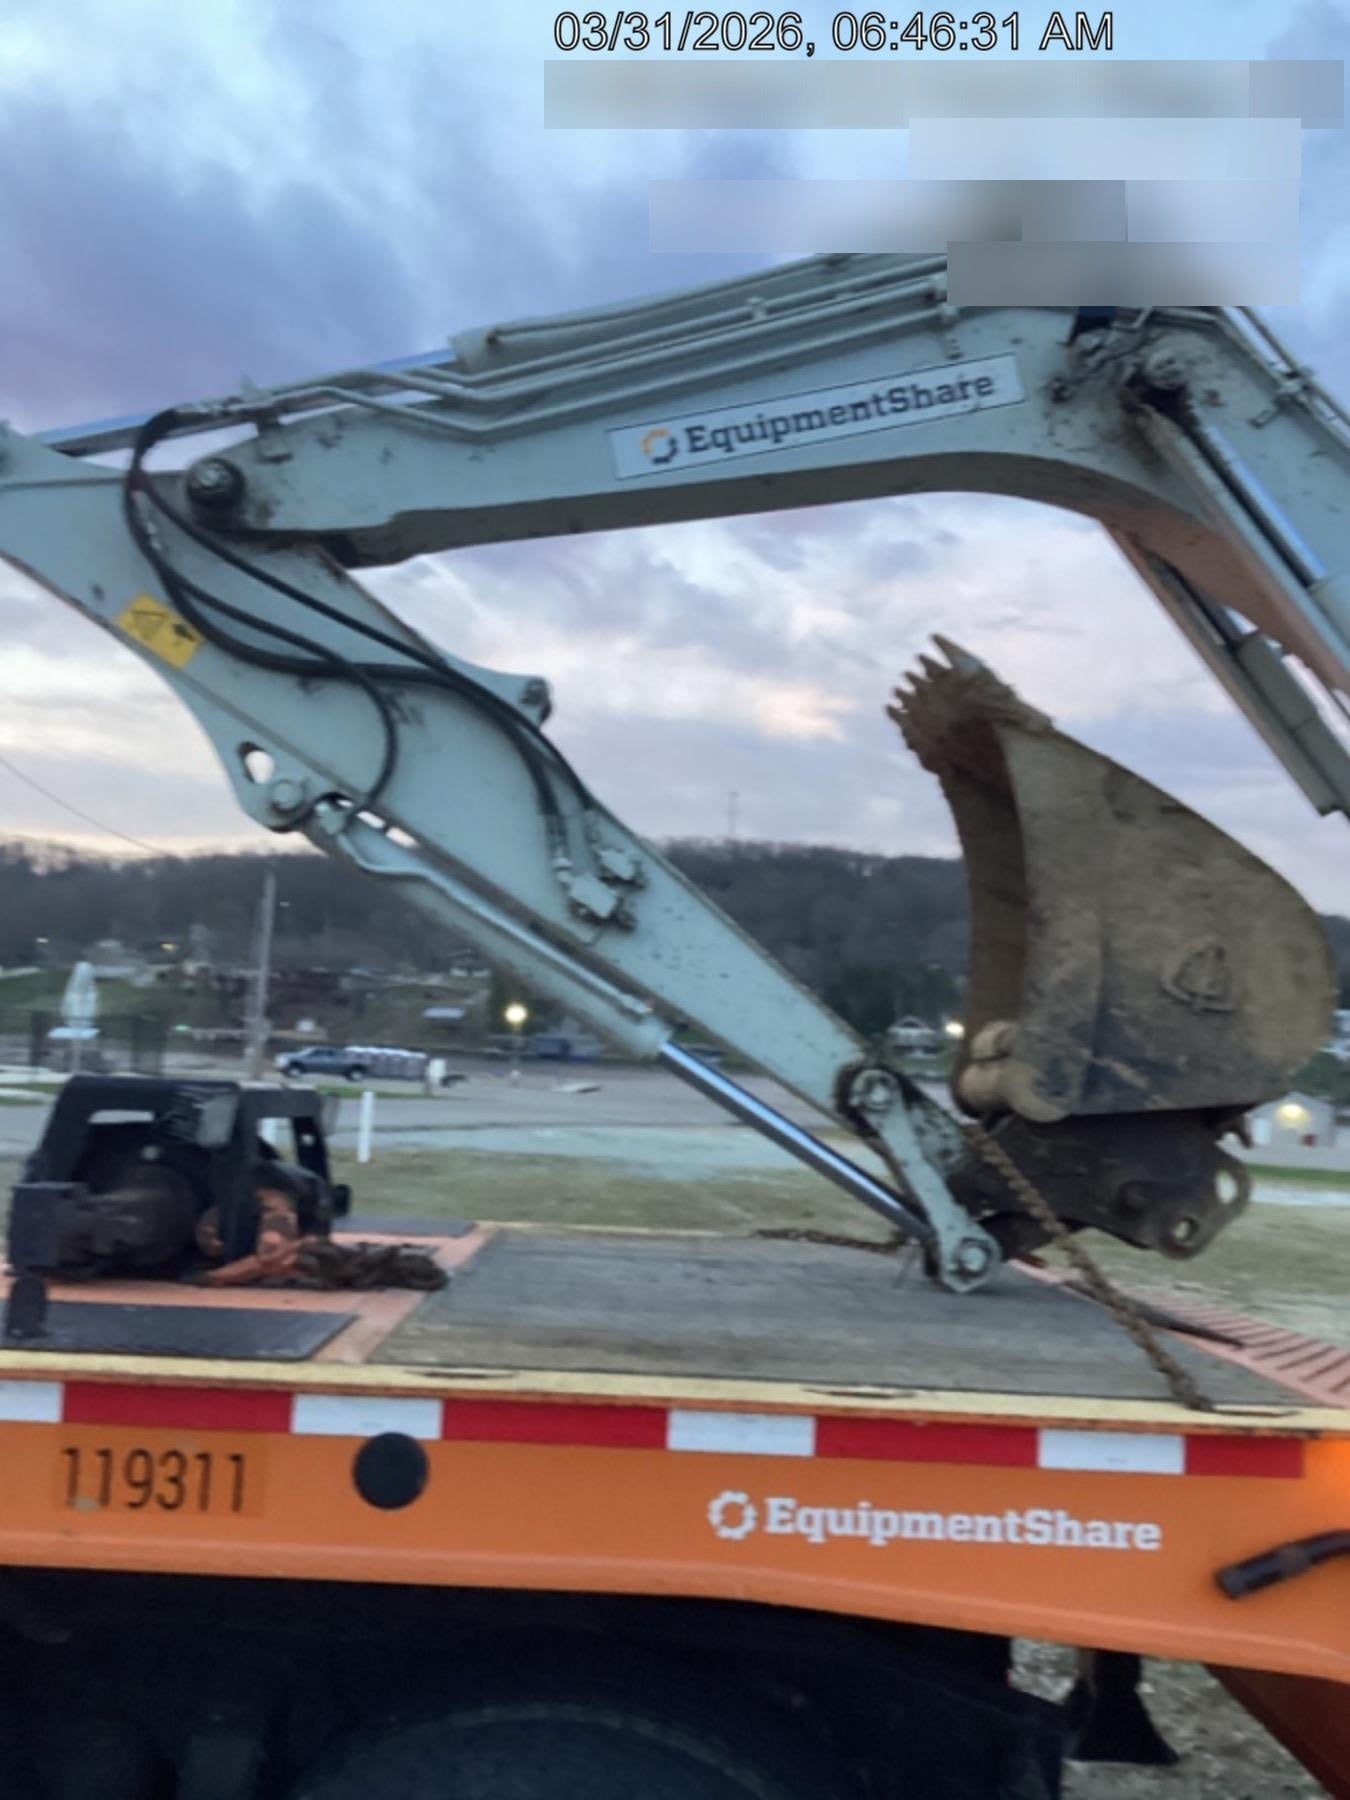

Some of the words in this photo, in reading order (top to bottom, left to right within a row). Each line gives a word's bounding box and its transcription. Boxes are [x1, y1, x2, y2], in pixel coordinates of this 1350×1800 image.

[686, 374, 995, 453] EquipmentShare
[62, 1447, 245, 1513] 119311
[764, 1497, 1162, 1550] EquipmentShare
